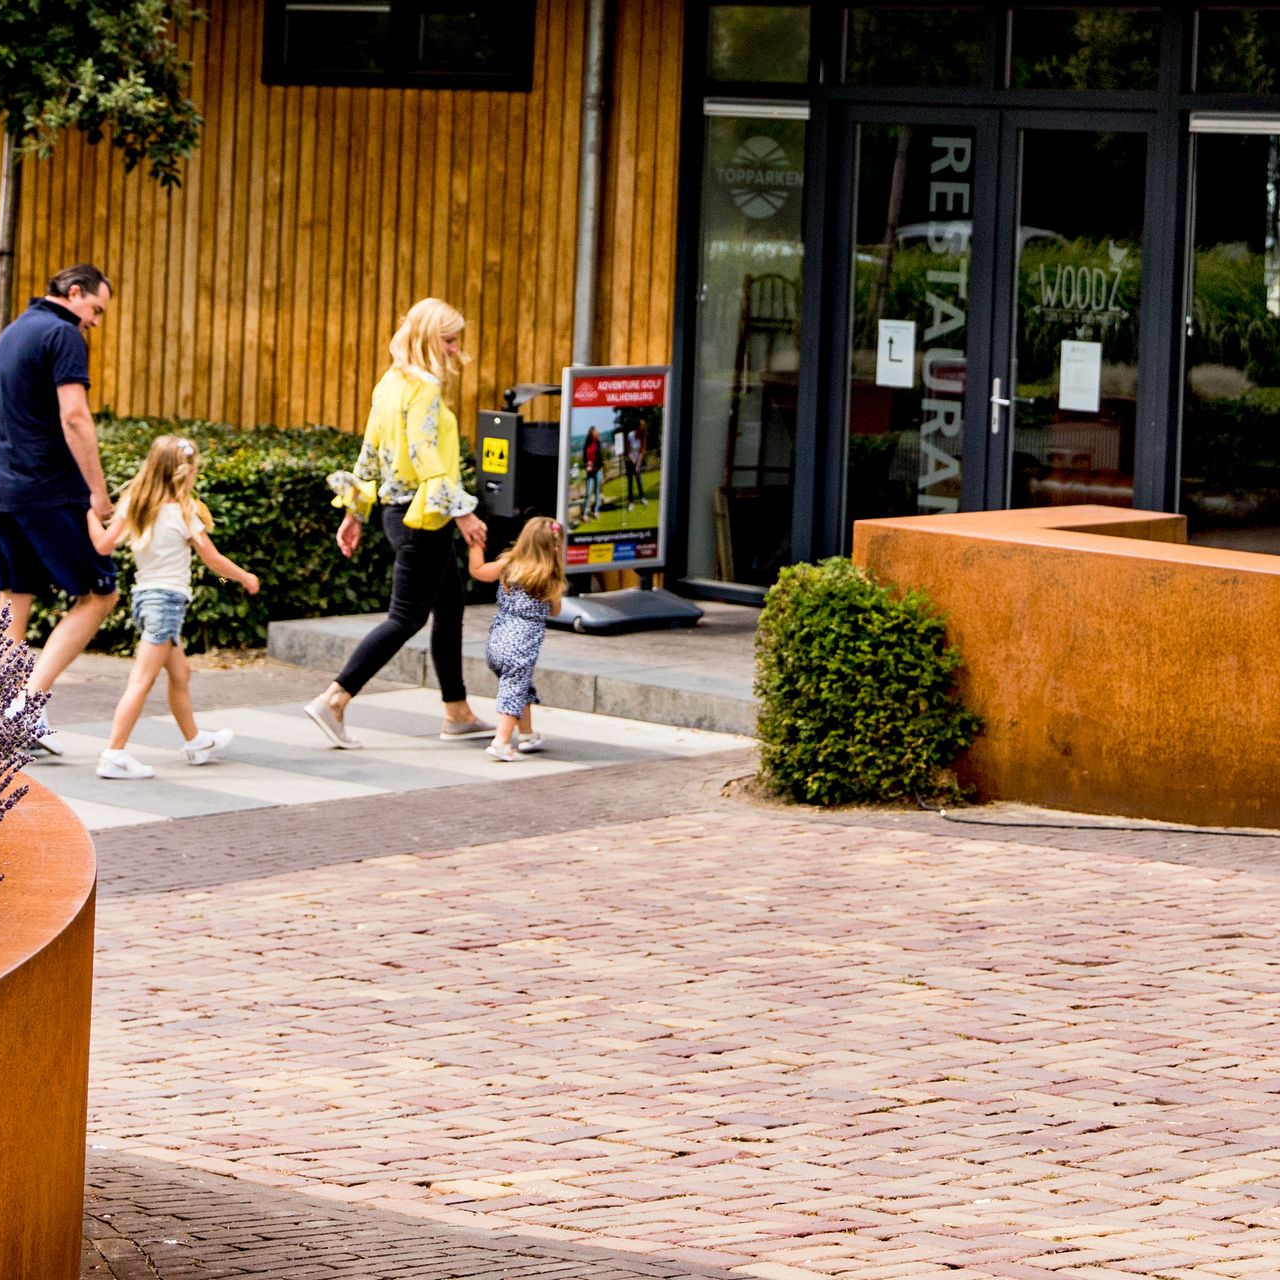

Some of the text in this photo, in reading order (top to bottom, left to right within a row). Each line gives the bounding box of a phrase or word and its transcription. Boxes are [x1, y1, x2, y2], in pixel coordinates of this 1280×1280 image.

[1040, 263, 1122, 312] WOODZ
[597, 379, 662, 391] ADVENTURE GOLF
[605, 391, 654, 402] VALKENBURG
